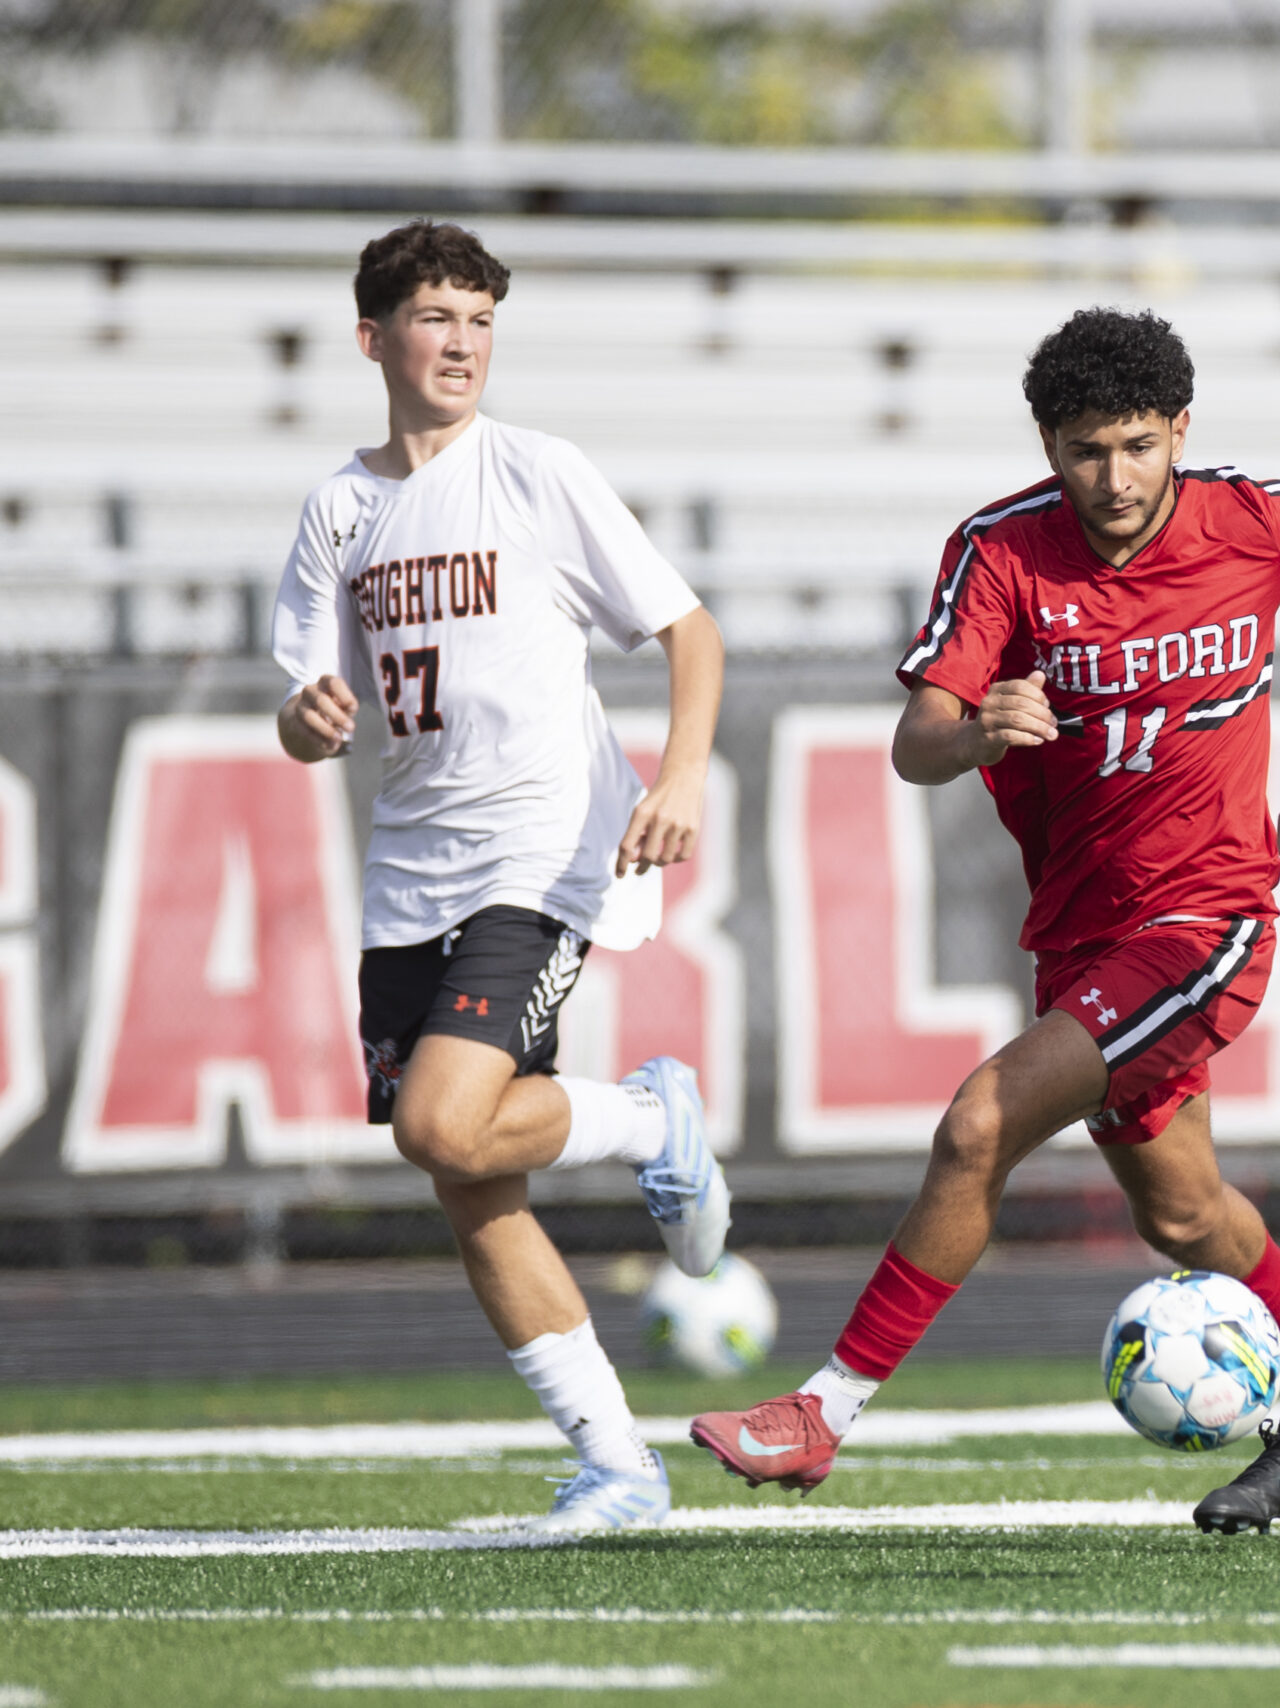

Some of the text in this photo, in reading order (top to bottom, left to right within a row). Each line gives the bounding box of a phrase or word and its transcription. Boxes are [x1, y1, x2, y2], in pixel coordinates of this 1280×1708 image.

[380, 645, 443, 737] 27
[1031, 614, 1259, 695] MILFORD
[1098, 706, 1168, 778] 11
